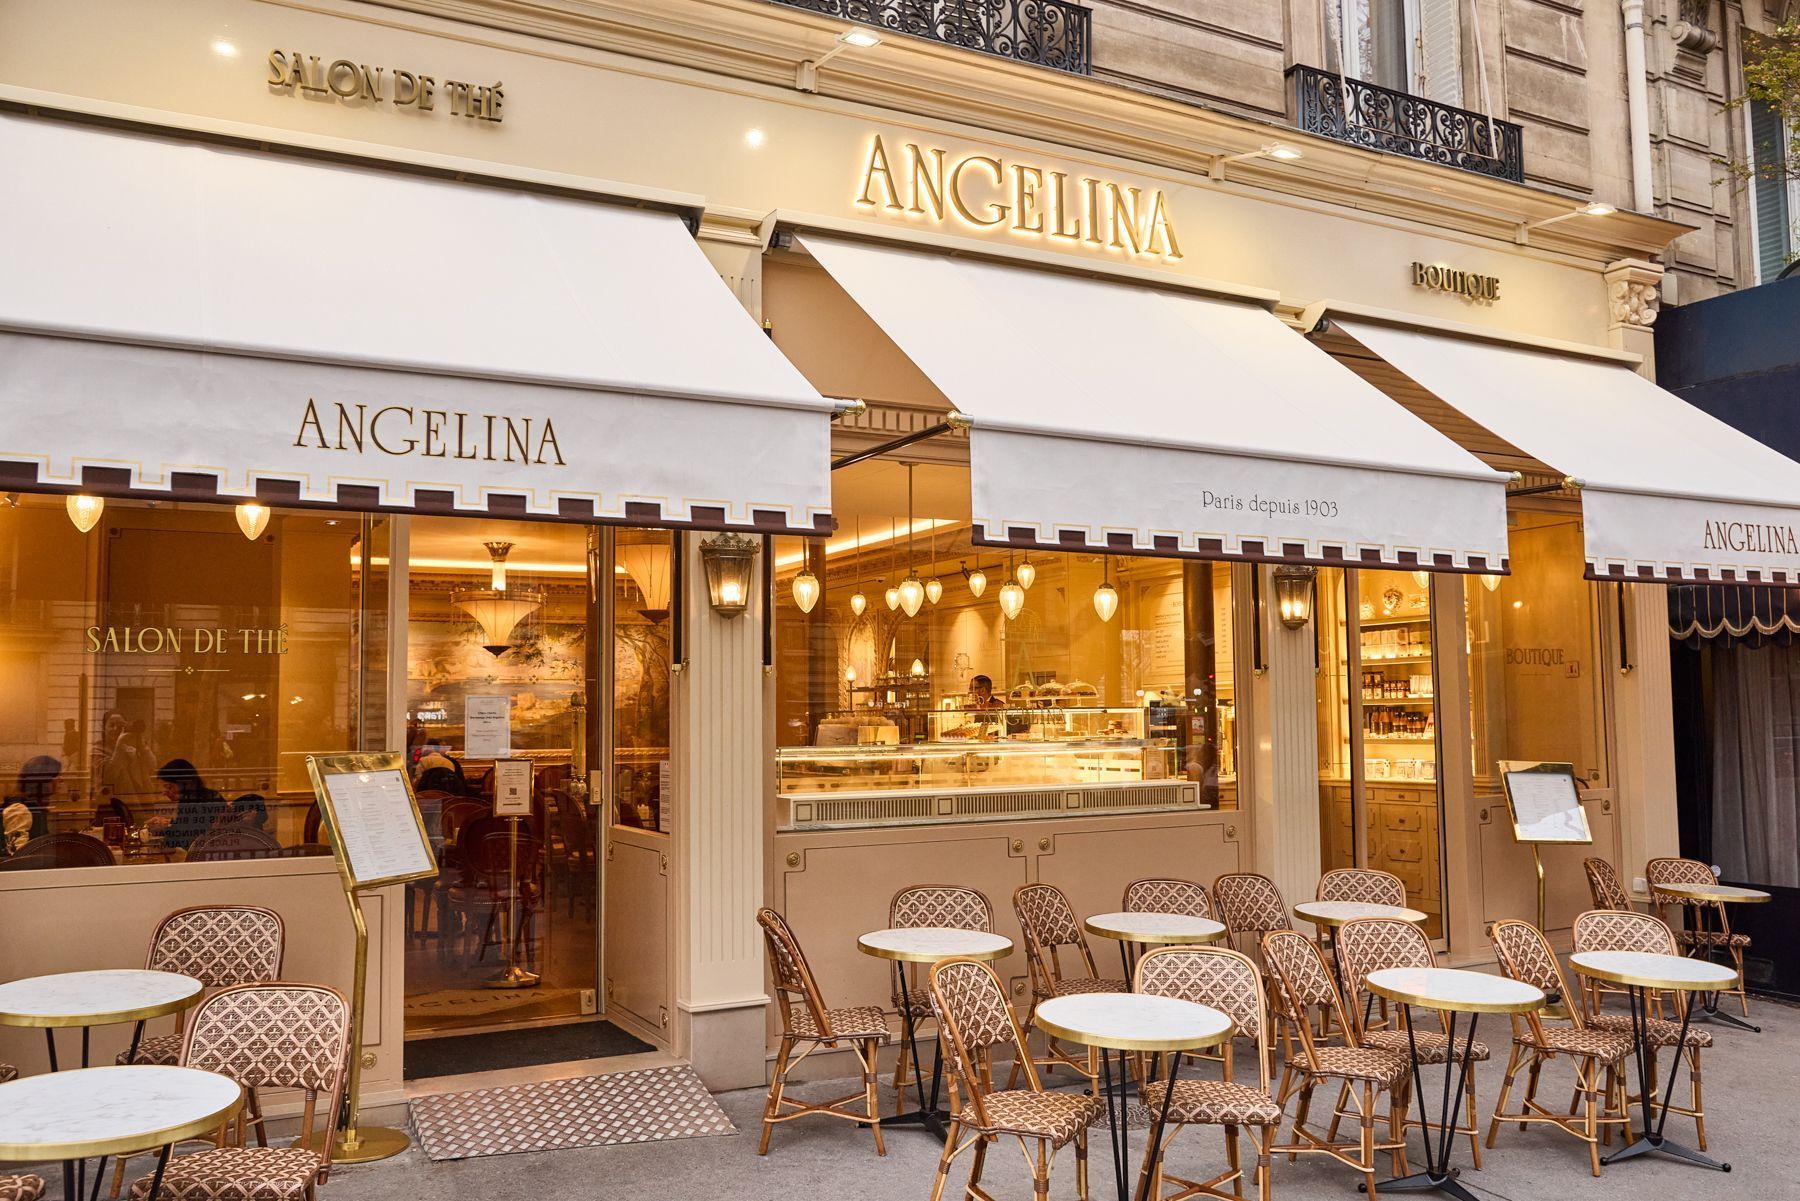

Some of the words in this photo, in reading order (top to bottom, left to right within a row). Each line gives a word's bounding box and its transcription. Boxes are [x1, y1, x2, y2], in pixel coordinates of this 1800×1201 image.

[267, 48, 384, 103] SALON
[393, 69, 436, 111] DE
[444, 81, 505, 122] THÉ
[856, 133, 1185, 258] ANGELINA
[1410, 261, 1500, 301] BOUTIQUE
[292, 397, 567, 466] ANGELINA
[1202, 490, 1244, 511] Paris
[1248, 494, 1301, 518] depuis
[1304, 499, 1339, 517] 1903
[1703, 519, 1799, 555] ANGELINA
[86, 626, 182, 653] SALON
[194, 628, 228, 654] DE
[238, 623, 288, 655] THÉ
[1506, 647, 1565, 667] BOUTIQUE
[984, 707, 1067, 726] ANGELINA
